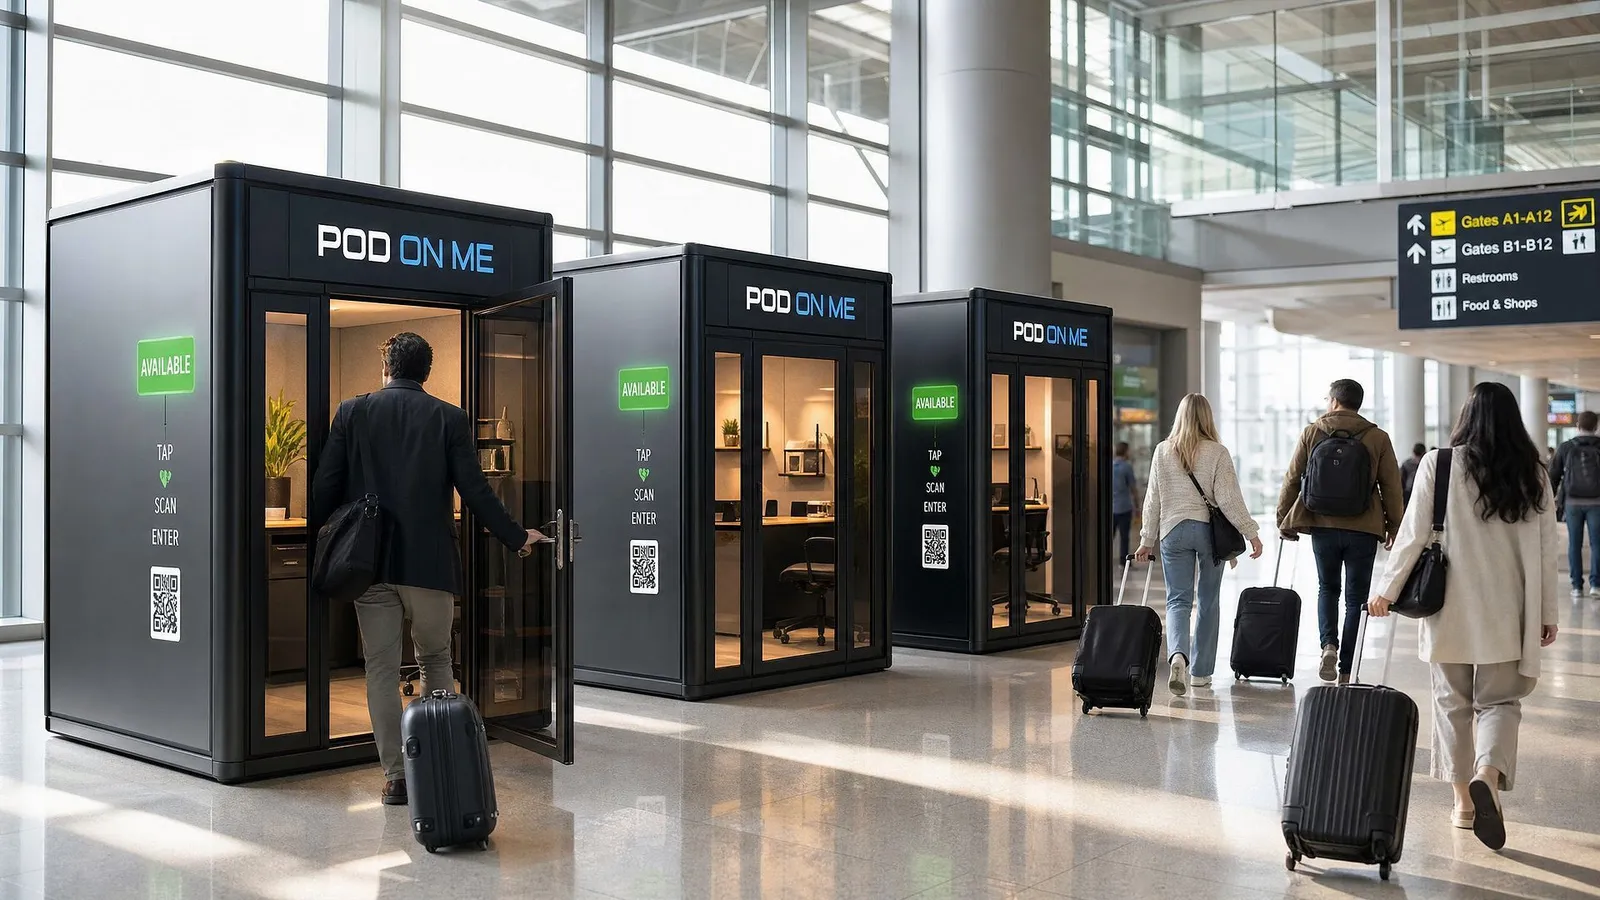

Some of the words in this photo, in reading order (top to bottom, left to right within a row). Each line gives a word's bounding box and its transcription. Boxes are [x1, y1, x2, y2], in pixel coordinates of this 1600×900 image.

[1461, 216, 1499, 228] Gates
[1502, 210, 1553, 225] A1-A12
[317, 223, 391, 263] POD
[399, 234, 444, 269] ON
[451, 240, 494, 274] ME
[1461, 243, 1500, 256] Gates
[1503, 237, 1553, 253] B1-B12
[1462, 271, 1519, 284] Restrooms
[746, 285, 791, 314] POD
[795, 291, 824, 317] ON
[828, 295, 856, 321] ME
[1462, 300, 1490, 312] Food
[1492, 300, 1501, 310] &
[1503, 298, 1538, 311] Shops
[1013, 320, 1044, 344] POD
[1046, 324, 1067, 345] ON
[1068, 327, 1088, 347] ME
[140, 354, 191, 377] AVAILABLE
[621, 380, 666, 397] AVAILABLE
[915, 395, 955, 410] AVAILABLE
[156, 443, 174, 462] TAP
[635, 448, 652, 462] TAP
[928, 449, 942, 461] TAP
[633, 488, 655, 502] SCAN
[925, 481, 945, 494] SCAN
[154, 497, 177, 515] SCAN
[923, 501, 947, 513] ENTER
[631, 511, 657, 526] ENTER
[151, 528, 180, 547] ENTER
